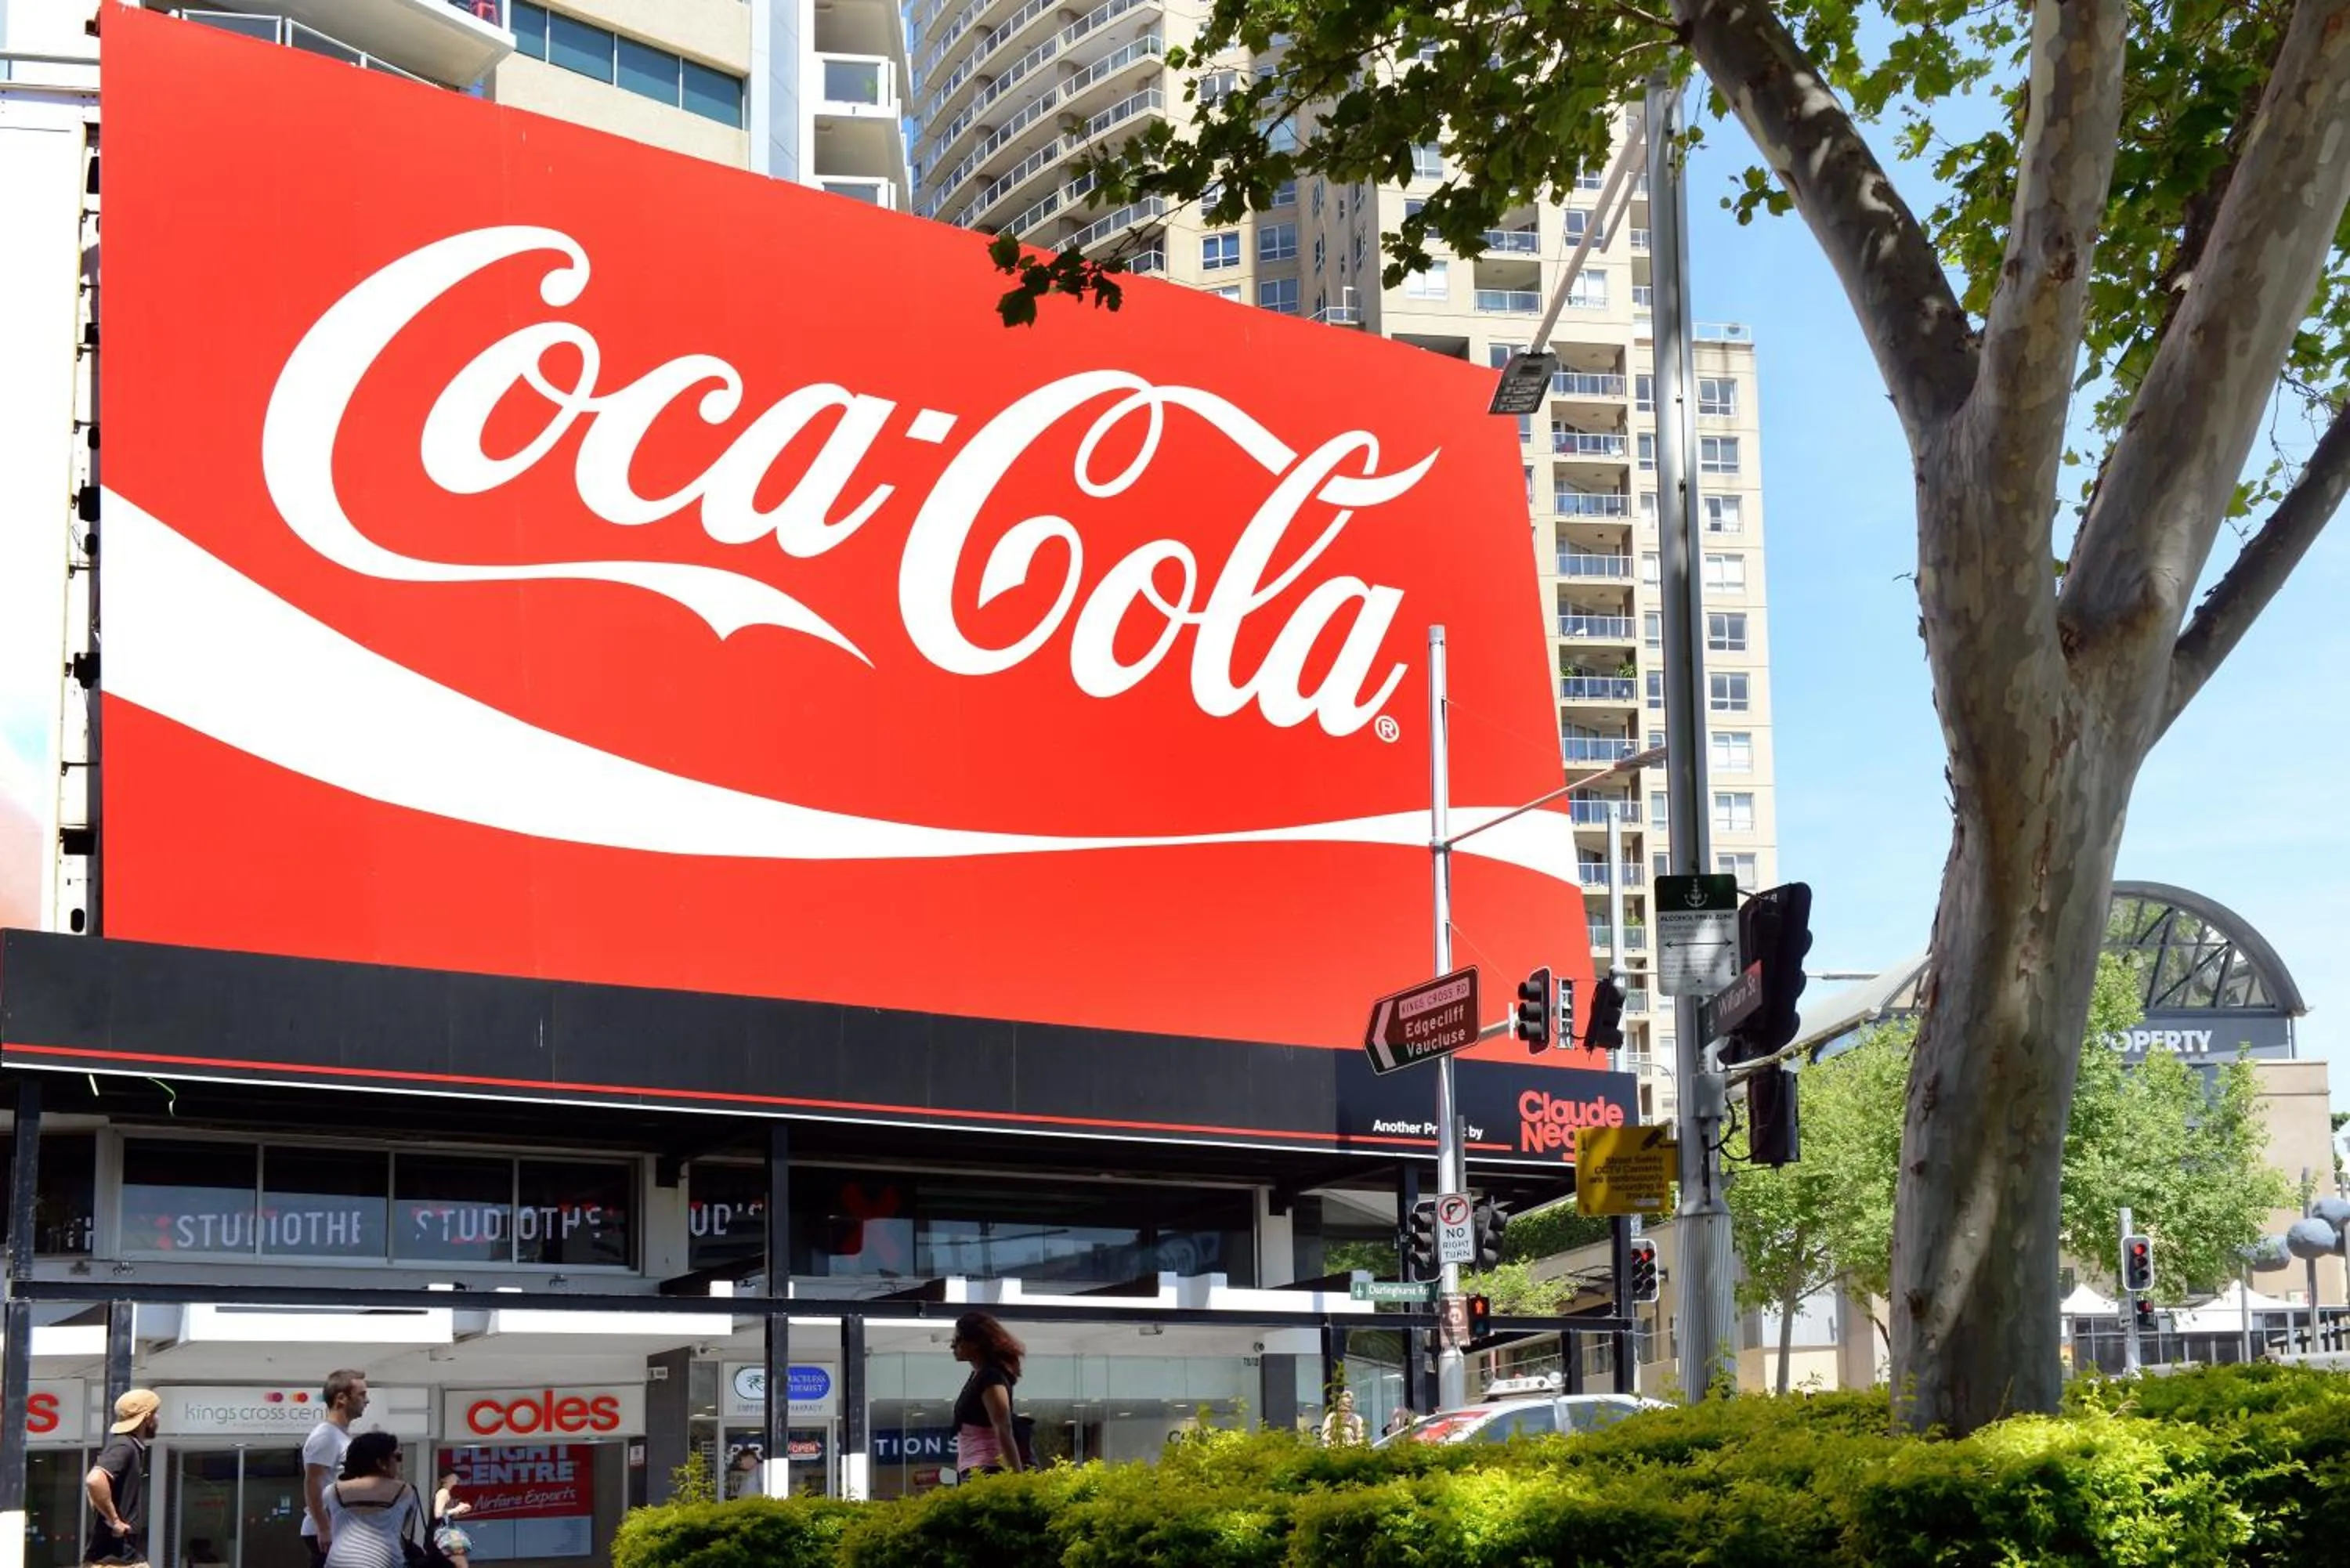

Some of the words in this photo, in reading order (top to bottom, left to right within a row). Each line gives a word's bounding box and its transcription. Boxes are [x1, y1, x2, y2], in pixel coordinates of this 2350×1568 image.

[262, 224, 1441, 738] Coca-Cola
[1426, 988, 1454, 1006] CROSS
[1456, 982, 1468, 997] RD
[1405, 1004, 1465, 1039] Edgecliff
[1406, 1028, 1466, 1058] Vaucluse
[1519, 1089, 1624, 1128] Claude
[1372, 1118, 1422, 1135] Another
[1468, 1125, 1484, 1141] by
[1520, 1121, 1576, 1153] Neo
[1442, 1240, 1470, 1250] RIGHT
[1445, 1227, 1466, 1240] NO
[1444, 1250, 1471, 1259] TURN
[1368, 1284, 1415, 1298] Darlinghurst
[1418, 1284, 1430, 1295] Rd
[185, 1403, 236, 1424] kings
[239, 1406, 286, 1421] cross
[466, 1389, 620, 1436] coles
[473, 1492, 523, 1511] Airfare
[524, 1487, 577, 1508] Experts
